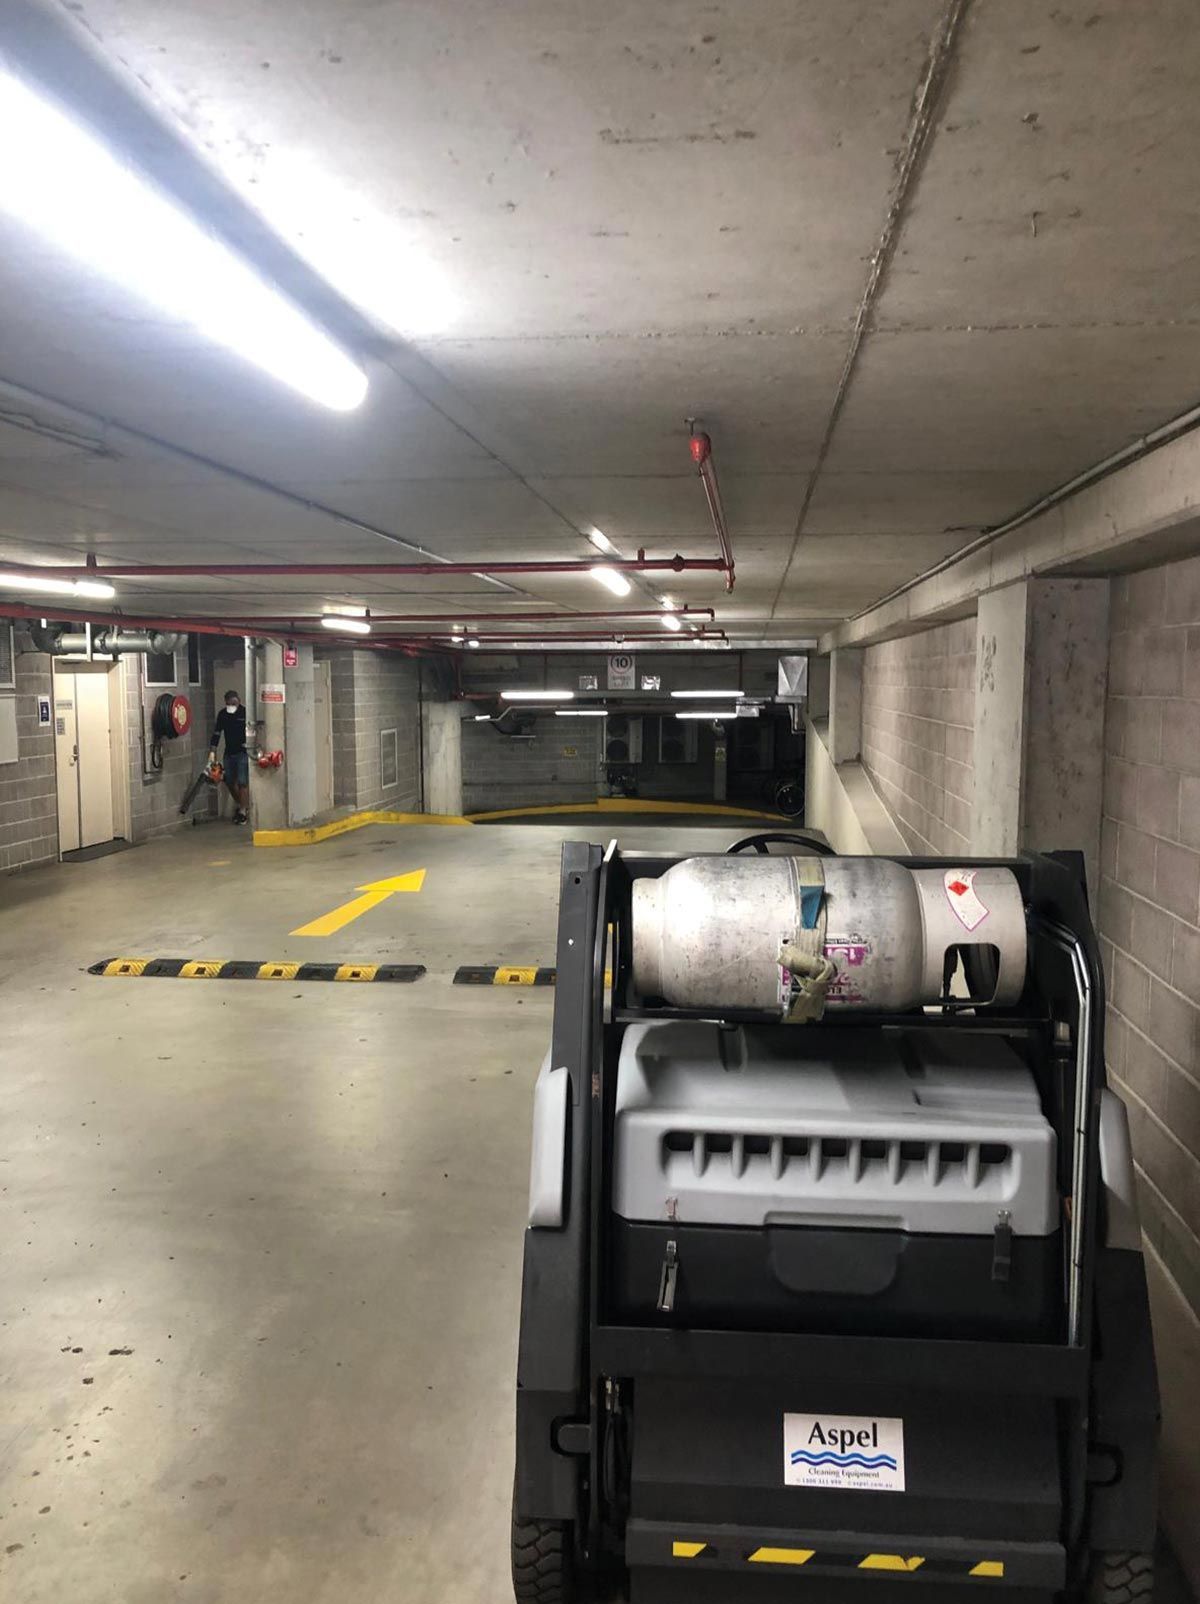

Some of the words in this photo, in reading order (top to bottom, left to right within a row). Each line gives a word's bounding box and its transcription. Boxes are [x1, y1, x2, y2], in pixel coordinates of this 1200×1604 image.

[615, 658, 628, 668] 10
[808, 1421, 878, 1454] Aspel
[808, 1467, 840, 1478] Cleaning
[841, 1469, 880, 1479] Equipment
